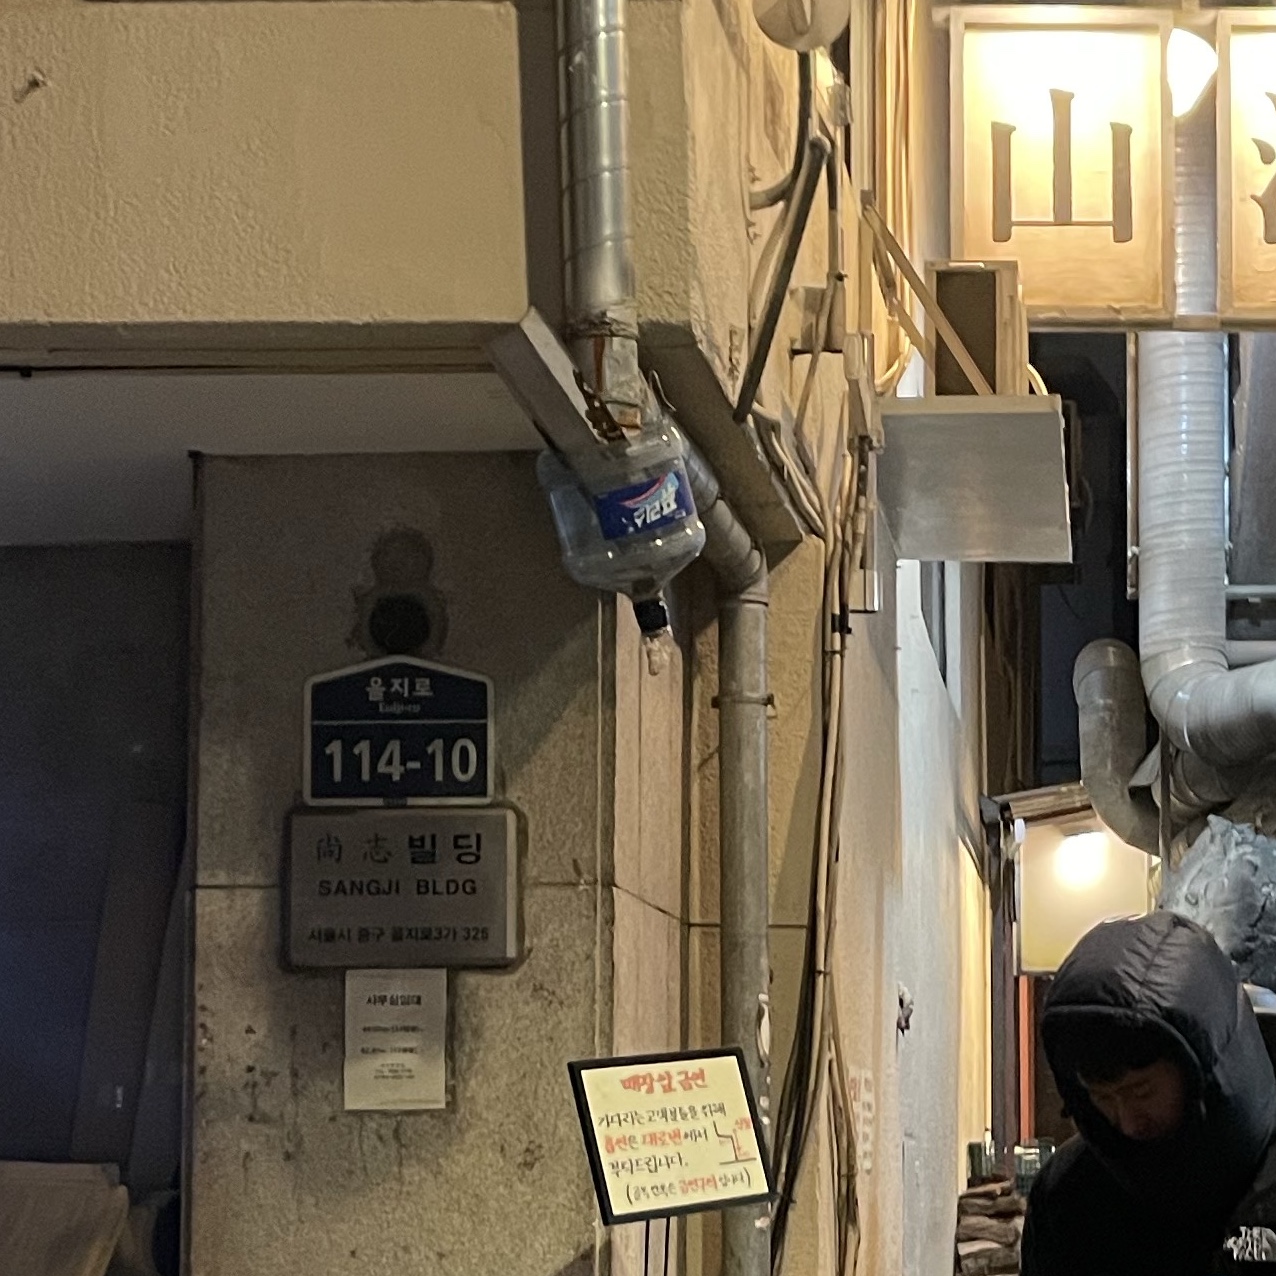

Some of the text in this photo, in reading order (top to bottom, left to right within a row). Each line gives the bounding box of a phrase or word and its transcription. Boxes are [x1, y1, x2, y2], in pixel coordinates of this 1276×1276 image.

[365, 676, 434, 701] 을지로
[324, 738, 477, 782] 114-10
[318, 879, 477, 896] SANGJI BLDG
